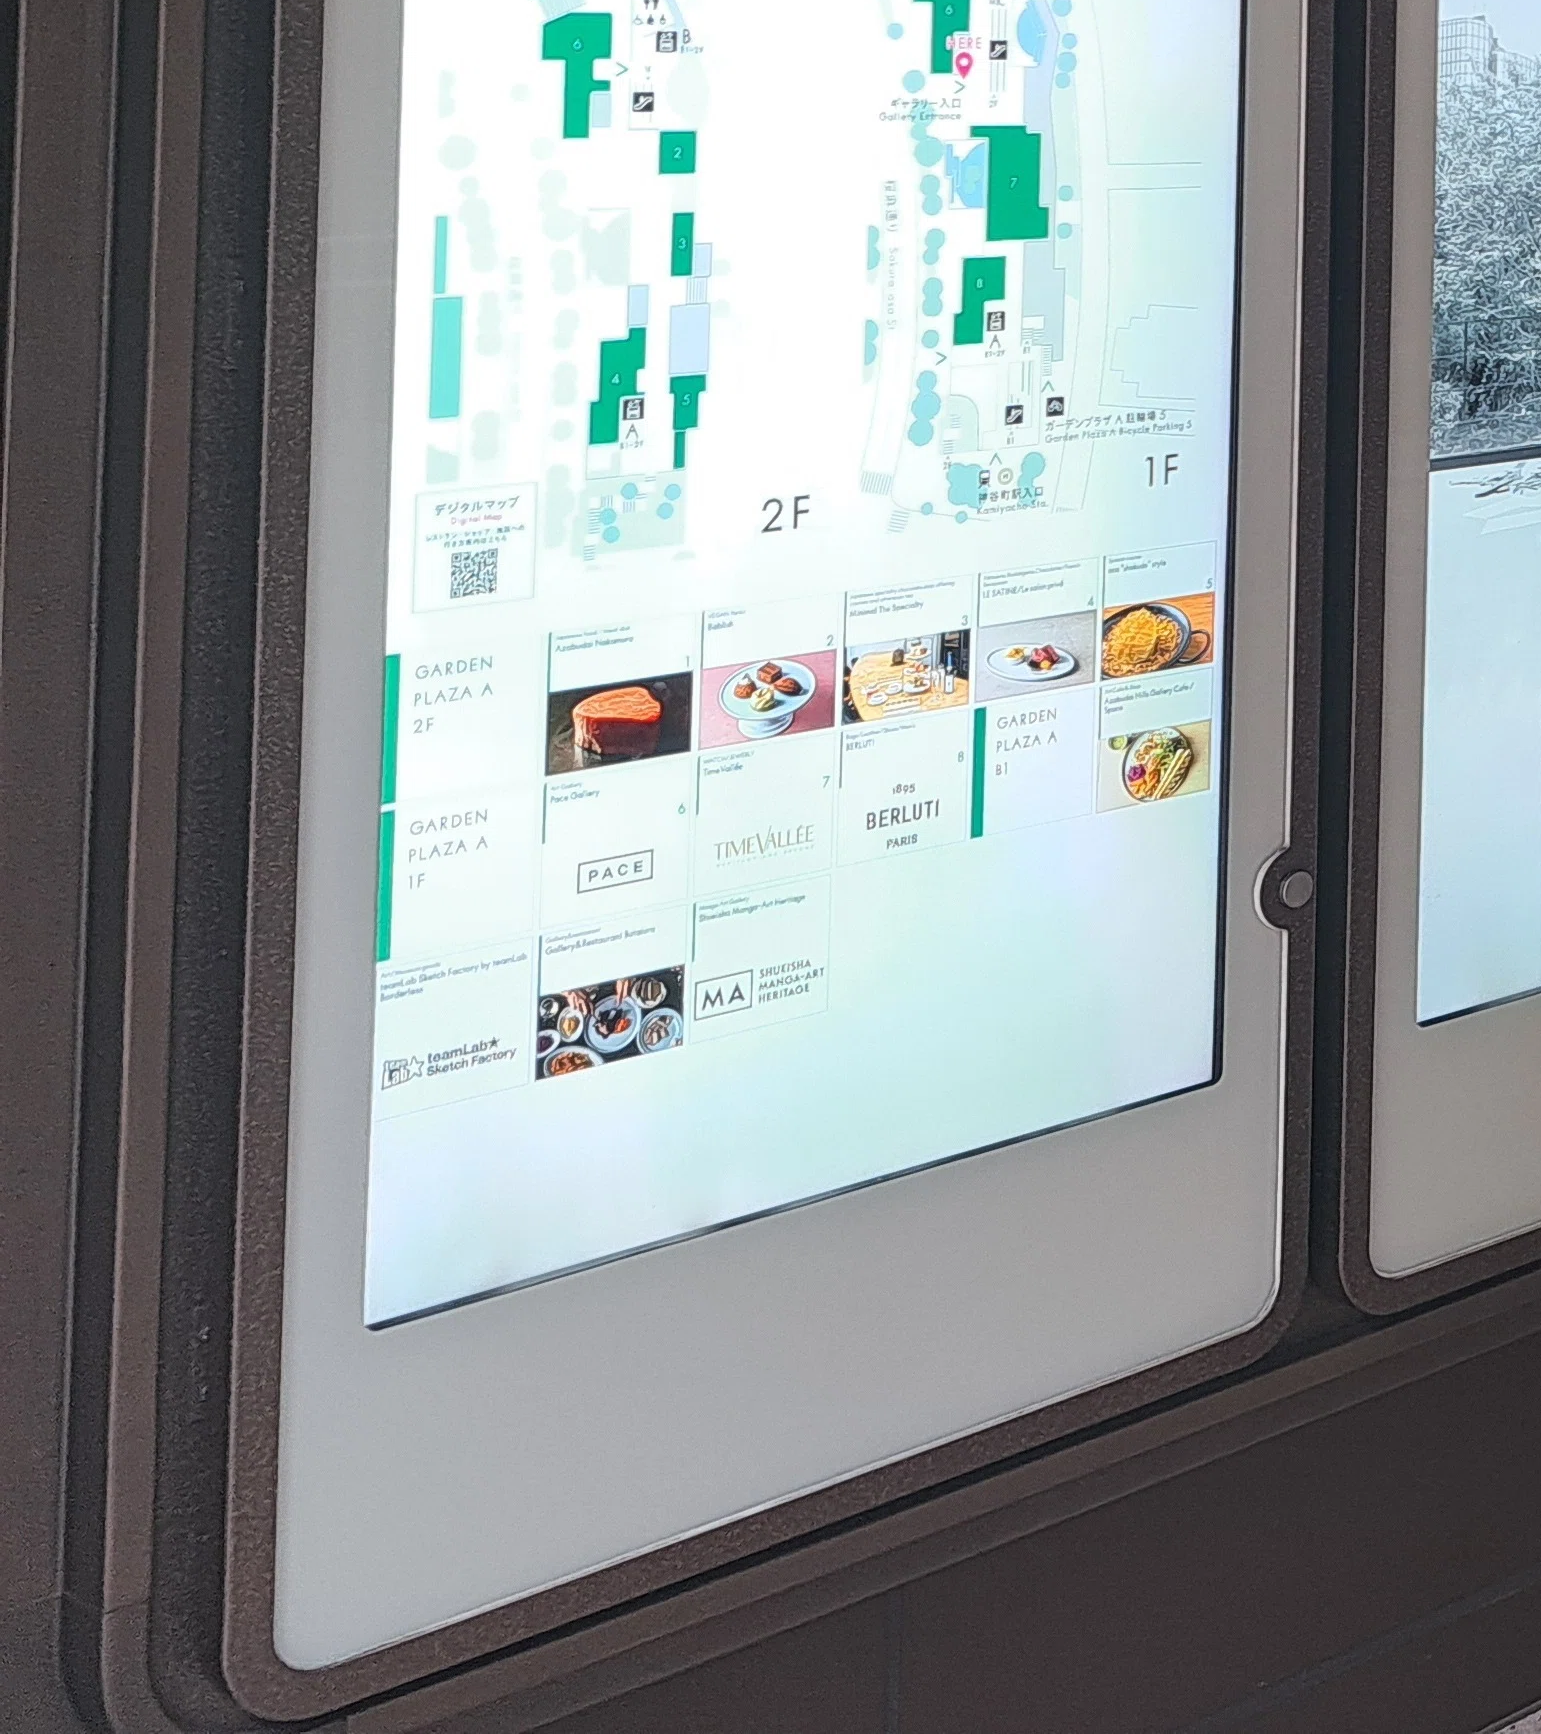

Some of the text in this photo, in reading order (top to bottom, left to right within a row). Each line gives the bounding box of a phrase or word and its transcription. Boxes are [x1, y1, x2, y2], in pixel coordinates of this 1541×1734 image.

[626, 424, 639, 439] A
[1145, 453, 1179, 487] 1F
[435, 495, 520, 516] デジタルマップ
[761, 495, 811, 533] 2F
[1205, 578, 1214, 590] 5
[1087, 596, 1096, 608] 4
[961, 614, 969, 627] 3
[827, 634, 835, 647] 2
[415, 655, 494, 681] GARDEN
[414, 682, 494, 707] PLAZA A
[413, 717, 435, 735] 2F
[997, 708, 1058, 730] GARDEN
[996, 731, 1058, 754] PLAZA A
[995, 763, 1008, 777] B1
[823, 776, 831, 788] 7
[892, 783, 916, 795] 1895
[550, 788, 601, 804] Pace Gallery
[677, 804, 686, 815] 6
[866, 799, 940, 830] BERLUTI
[410, 809, 489, 836] GARDEN
[408, 836, 489, 864] PLAZA A
[886, 833, 918, 850] PARIS
[408, 873, 426, 890] 1F
[588, 860, 644, 883] PACE
[759, 959, 811, 979] SHUEISHA
[759, 967, 825, 991] MANGA-ART
[701, 982, 746, 1011] MA
[758, 983, 810, 1004] HERITAGE
[427, 1047, 517, 1077] Sketch Factory
